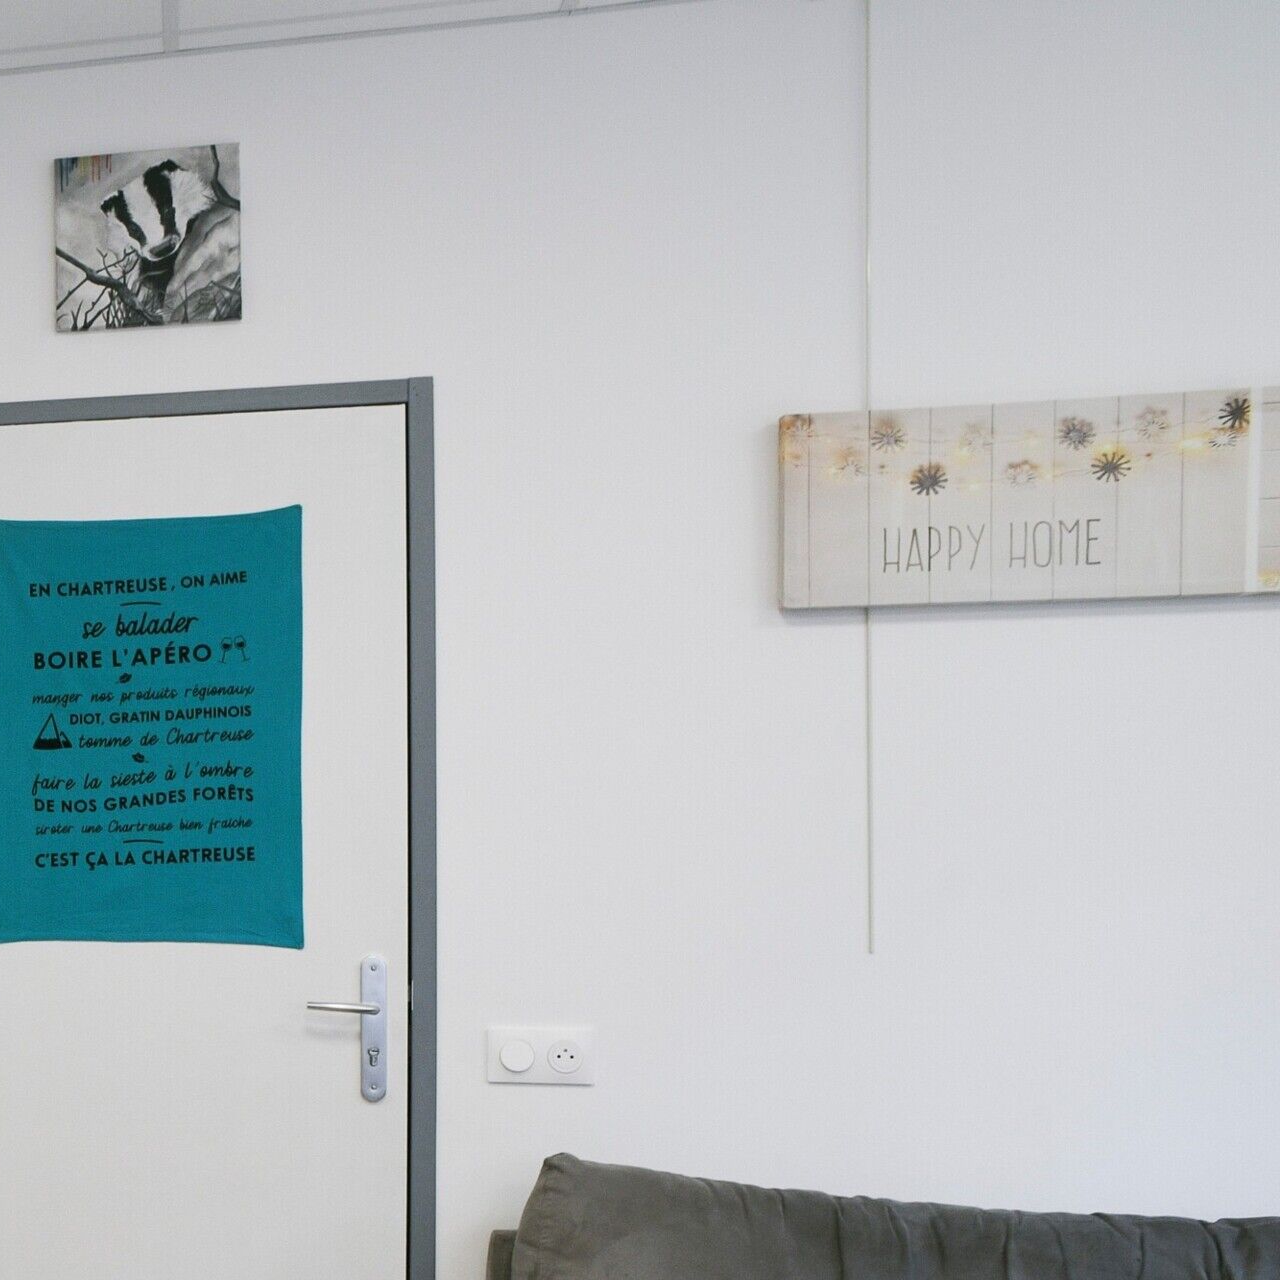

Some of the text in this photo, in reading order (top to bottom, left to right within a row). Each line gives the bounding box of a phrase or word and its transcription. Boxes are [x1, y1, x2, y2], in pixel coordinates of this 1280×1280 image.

[882, 518, 1102, 574] HAPPY HOME
[29, 582, 51, 597] EN
[180, 573, 205, 588] ON
[209, 571, 248, 585] AIME
[81, 611, 199, 639] se balader
[34, 641, 212, 669] BOIRE L'APÉRO
[32, 683, 255, 708] manger nos produits régionaux
[70, 705, 252, 726] DIOT, GRATIN DAUPHINOIS
[79, 727, 255, 748] tomme de Chartreuse
[32, 775, 76, 795] faire
[83, 773, 102, 789] la
[110, 768, 157, 788] sieste
[164, 769, 176, 781] à
[34, 786, 254, 813] DE NOS GRANDES FORÊTS
[81, 823, 103, 834] une
[108, 819, 174, 833] Chartreuse
[179, 818, 203, 831] bien
[35, 846, 256, 871] C'EST ÇA LA CHARTREUSE
